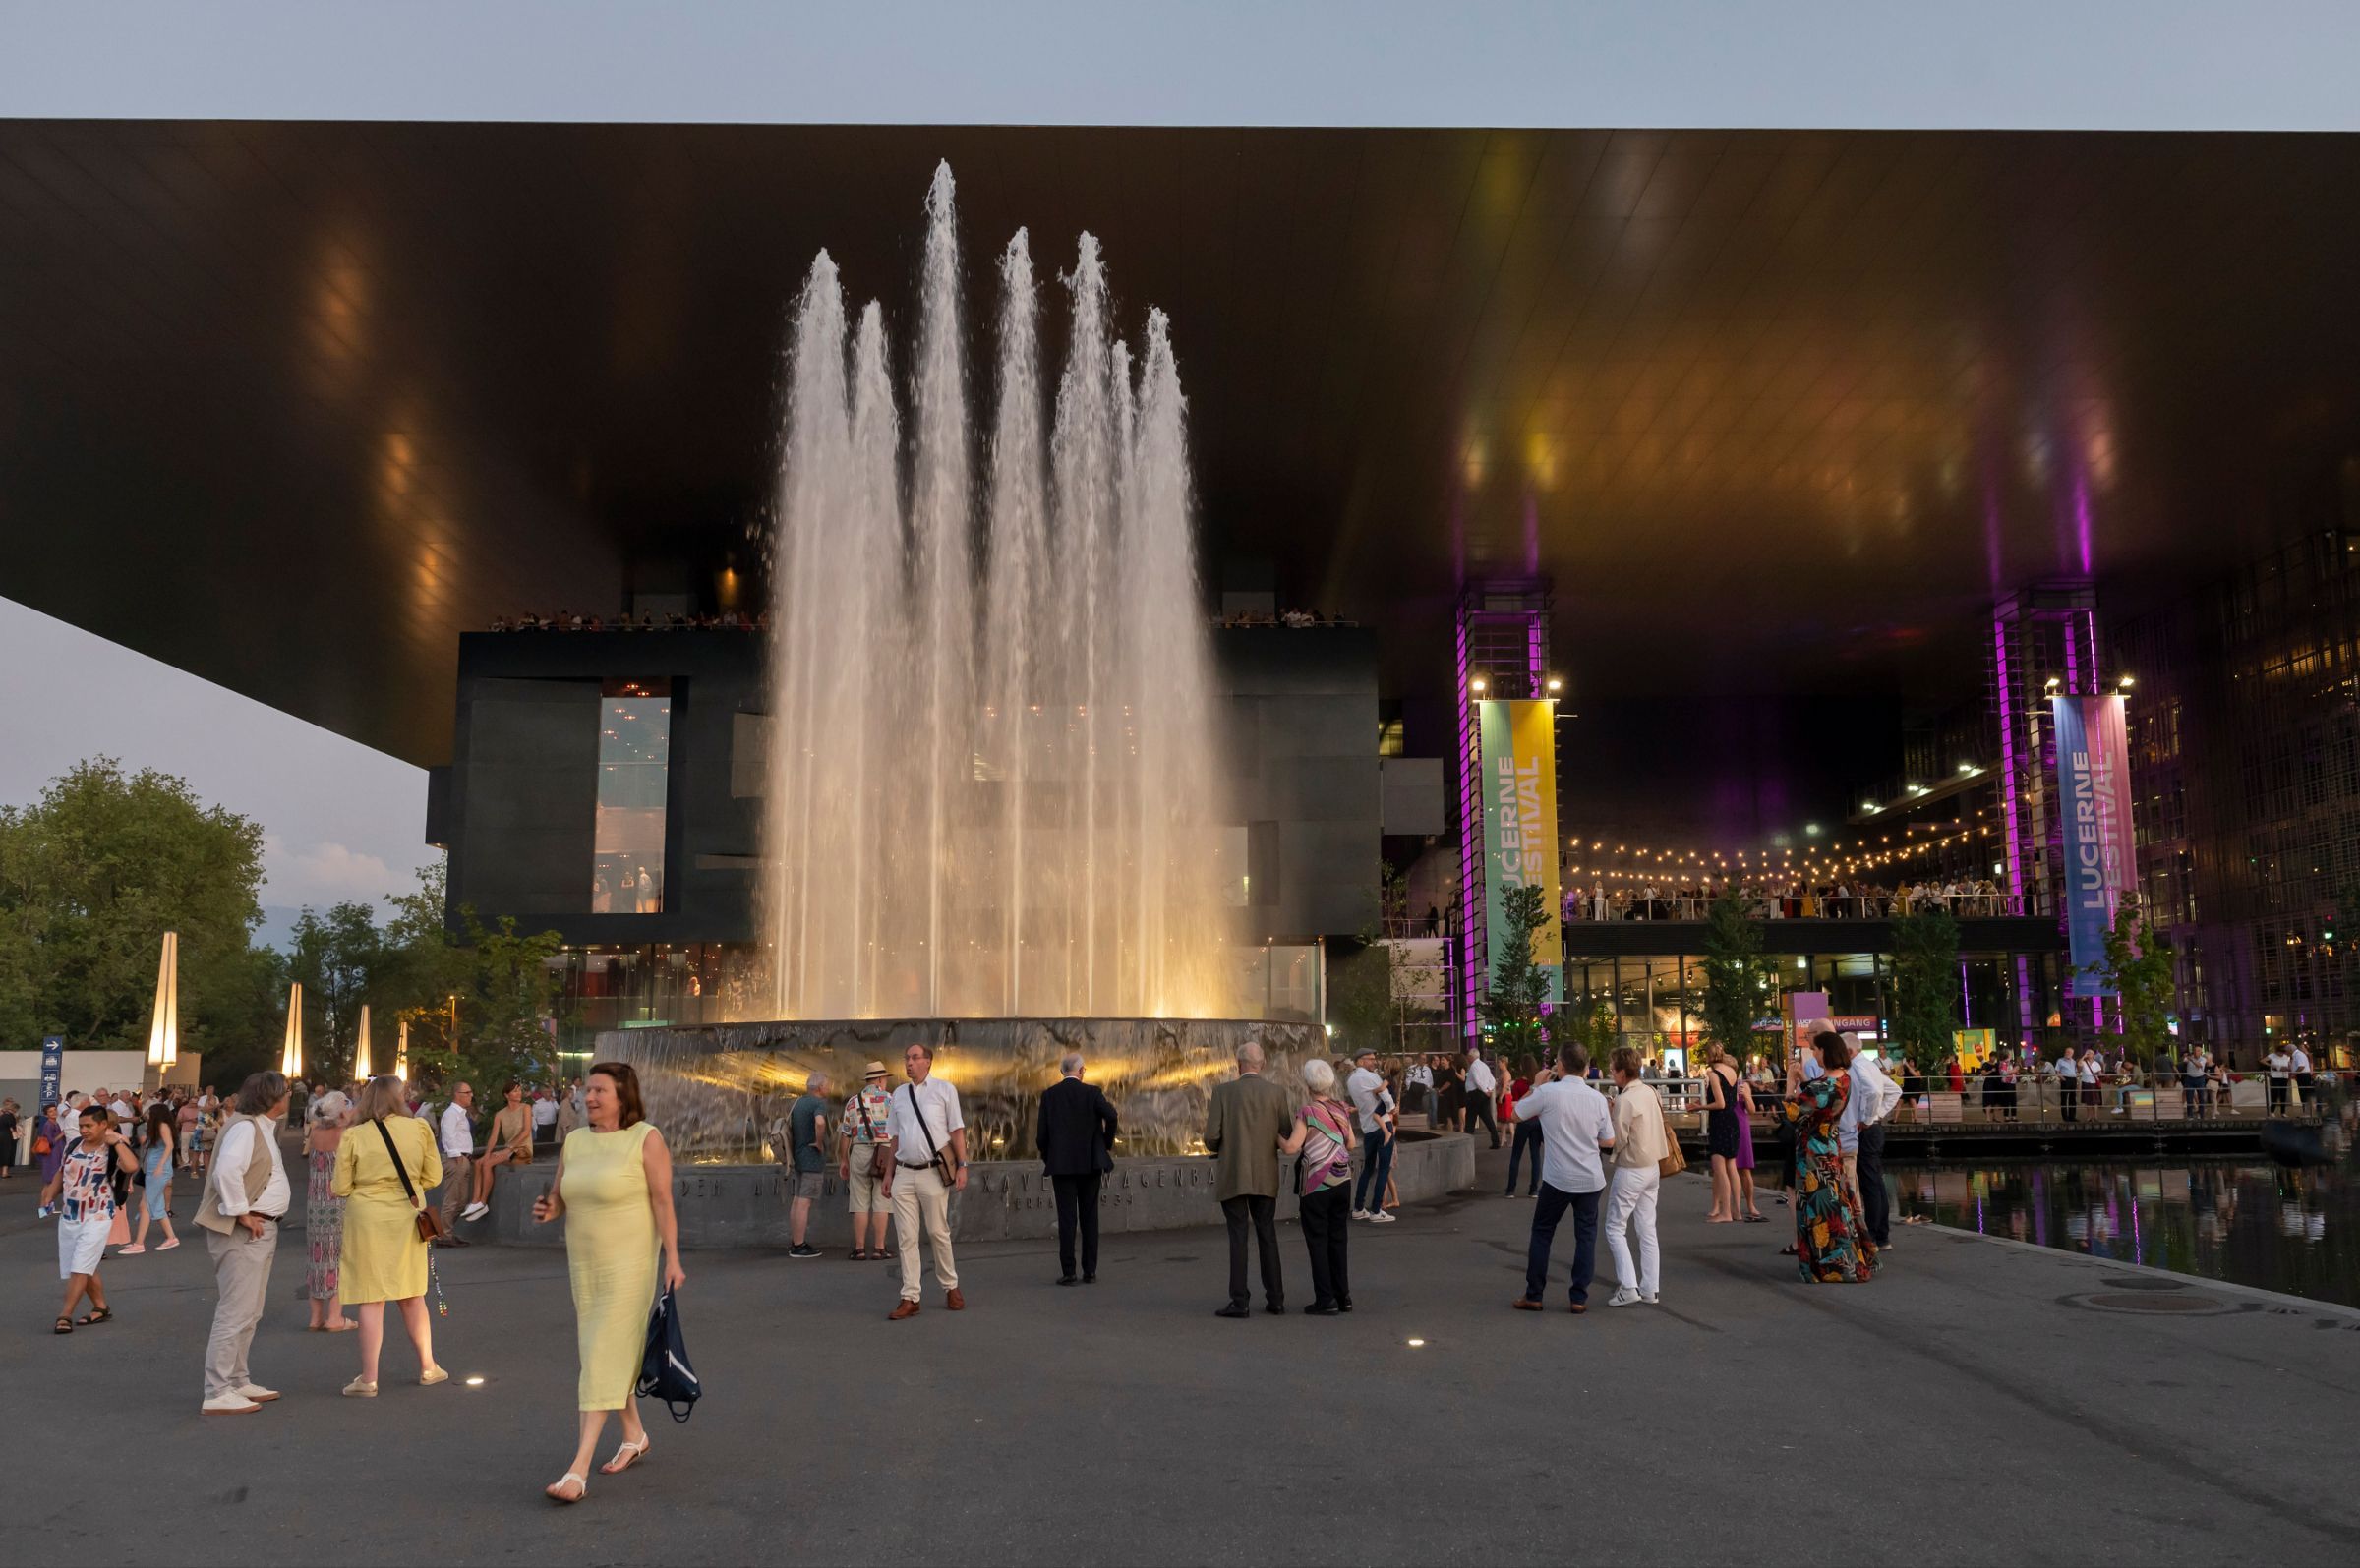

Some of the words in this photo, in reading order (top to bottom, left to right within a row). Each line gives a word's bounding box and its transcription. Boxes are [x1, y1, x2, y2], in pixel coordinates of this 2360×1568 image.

[1497, 756, 1522, 887] UCERNE
[1517, 756, 1543, 888] ESTIVAL
[2073, 752, 2106, 909] LUCERNE
[983, 1171, 1052, 1194] XAVE
